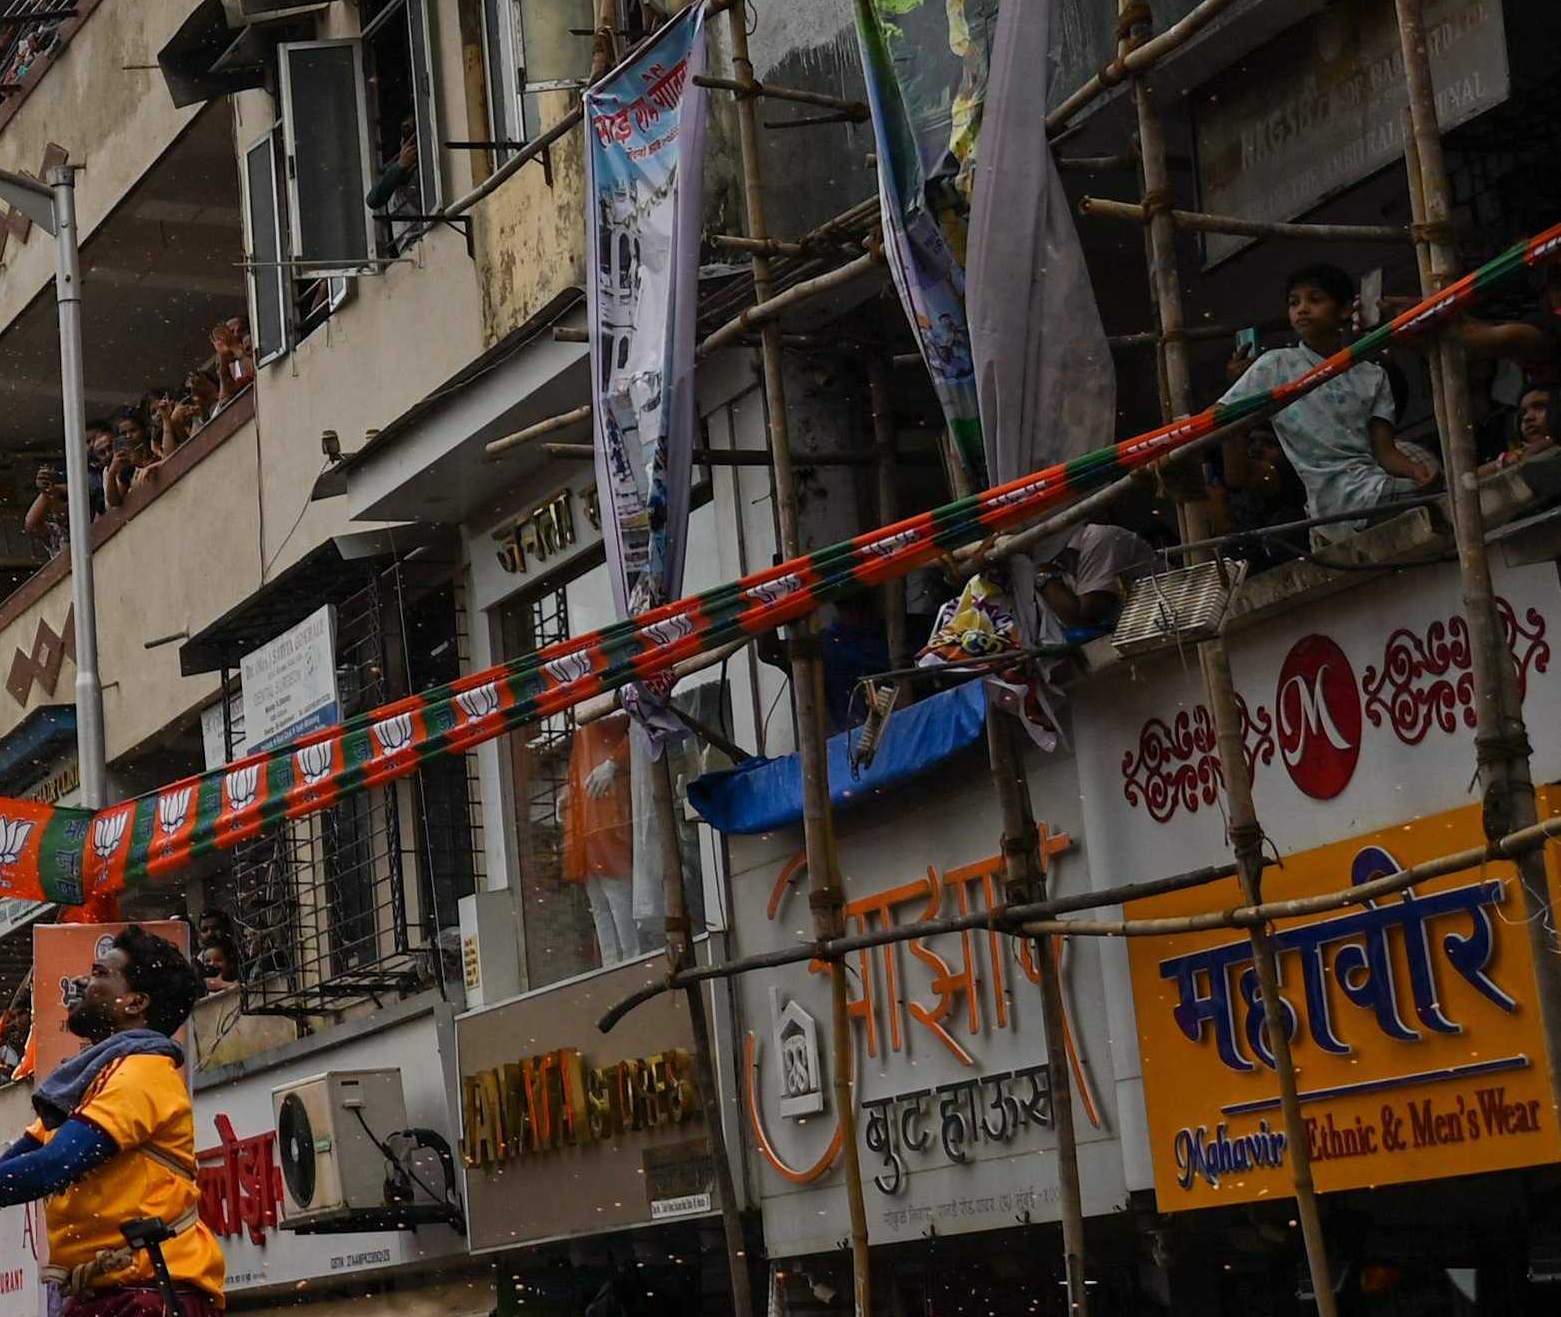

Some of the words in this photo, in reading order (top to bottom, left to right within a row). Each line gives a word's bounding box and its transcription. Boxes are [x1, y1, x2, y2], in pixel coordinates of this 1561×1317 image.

[492, 488, 576, 573] जनता
[1159, 846, 1516, 1073] महावीर
[1175, 1117, 1288, 1190] Mahavir
[1304, 1114, 1378, 1161] Ethnic
[1381, 1105, 1406, 1152] &
[1408, 1095, 1479, 1149] Men's
[1476, 1087, 1541, 1137] Wear
